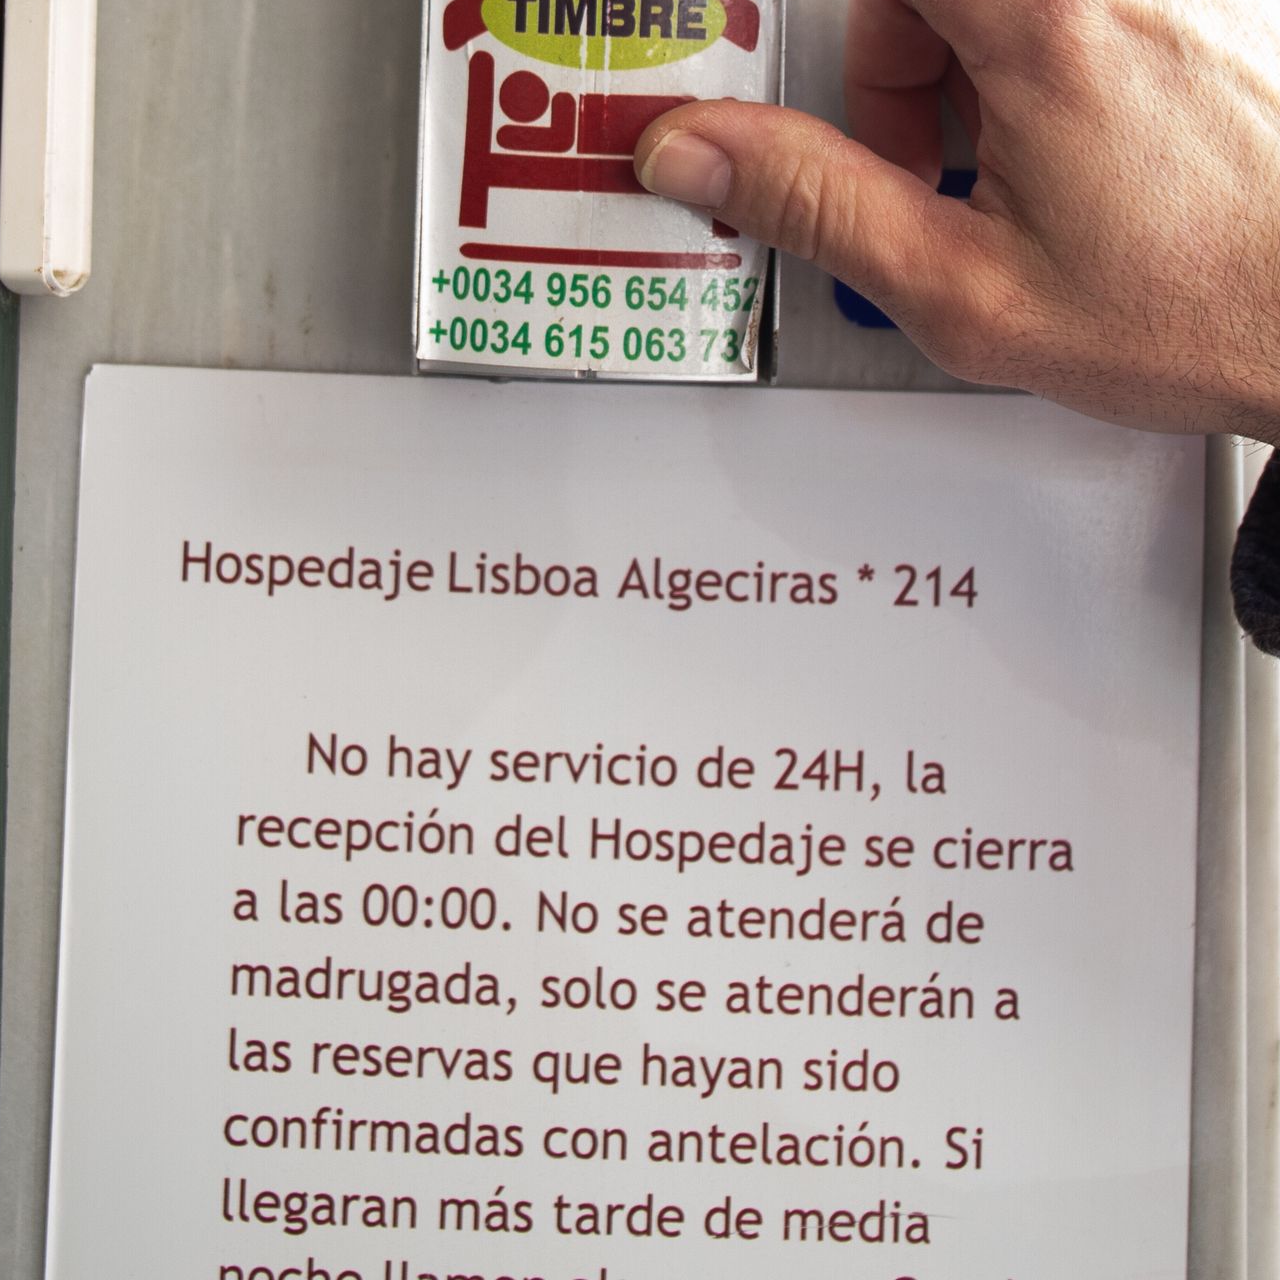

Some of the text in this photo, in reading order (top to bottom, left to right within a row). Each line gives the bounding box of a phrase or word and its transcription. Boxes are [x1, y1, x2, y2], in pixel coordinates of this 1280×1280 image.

[431, 265, 535, 305] +0034
[545, 271, 613, 310] 956
[624, 275, 689, 312] 654
[427, 315, 746, 363] +0034 615 063 73
[181, 539, 435, 602] Hospedaje
[448, 550, 600, 598] Lisboa
[616, 556, 839, 612] Algeciras
[893, 563, 979, 609] 214
[306, 731, 947, 802] No hay servicio de 24H, la
[237, 807, 1075, 878] recepción del Hospedaje se cierra
[232, 878, 985, 945] a las 00:00. No se atenderá de
[230, 955, 1021, 1021] madrugada, solo se atenderán a
[228, 1026, 901, 1100] las reservas que hayan sido
[222, 1105, 984, 1171] confirmadas con antelación. Si
[222, 1176, 931, 1245] llegaran más tarde de media
